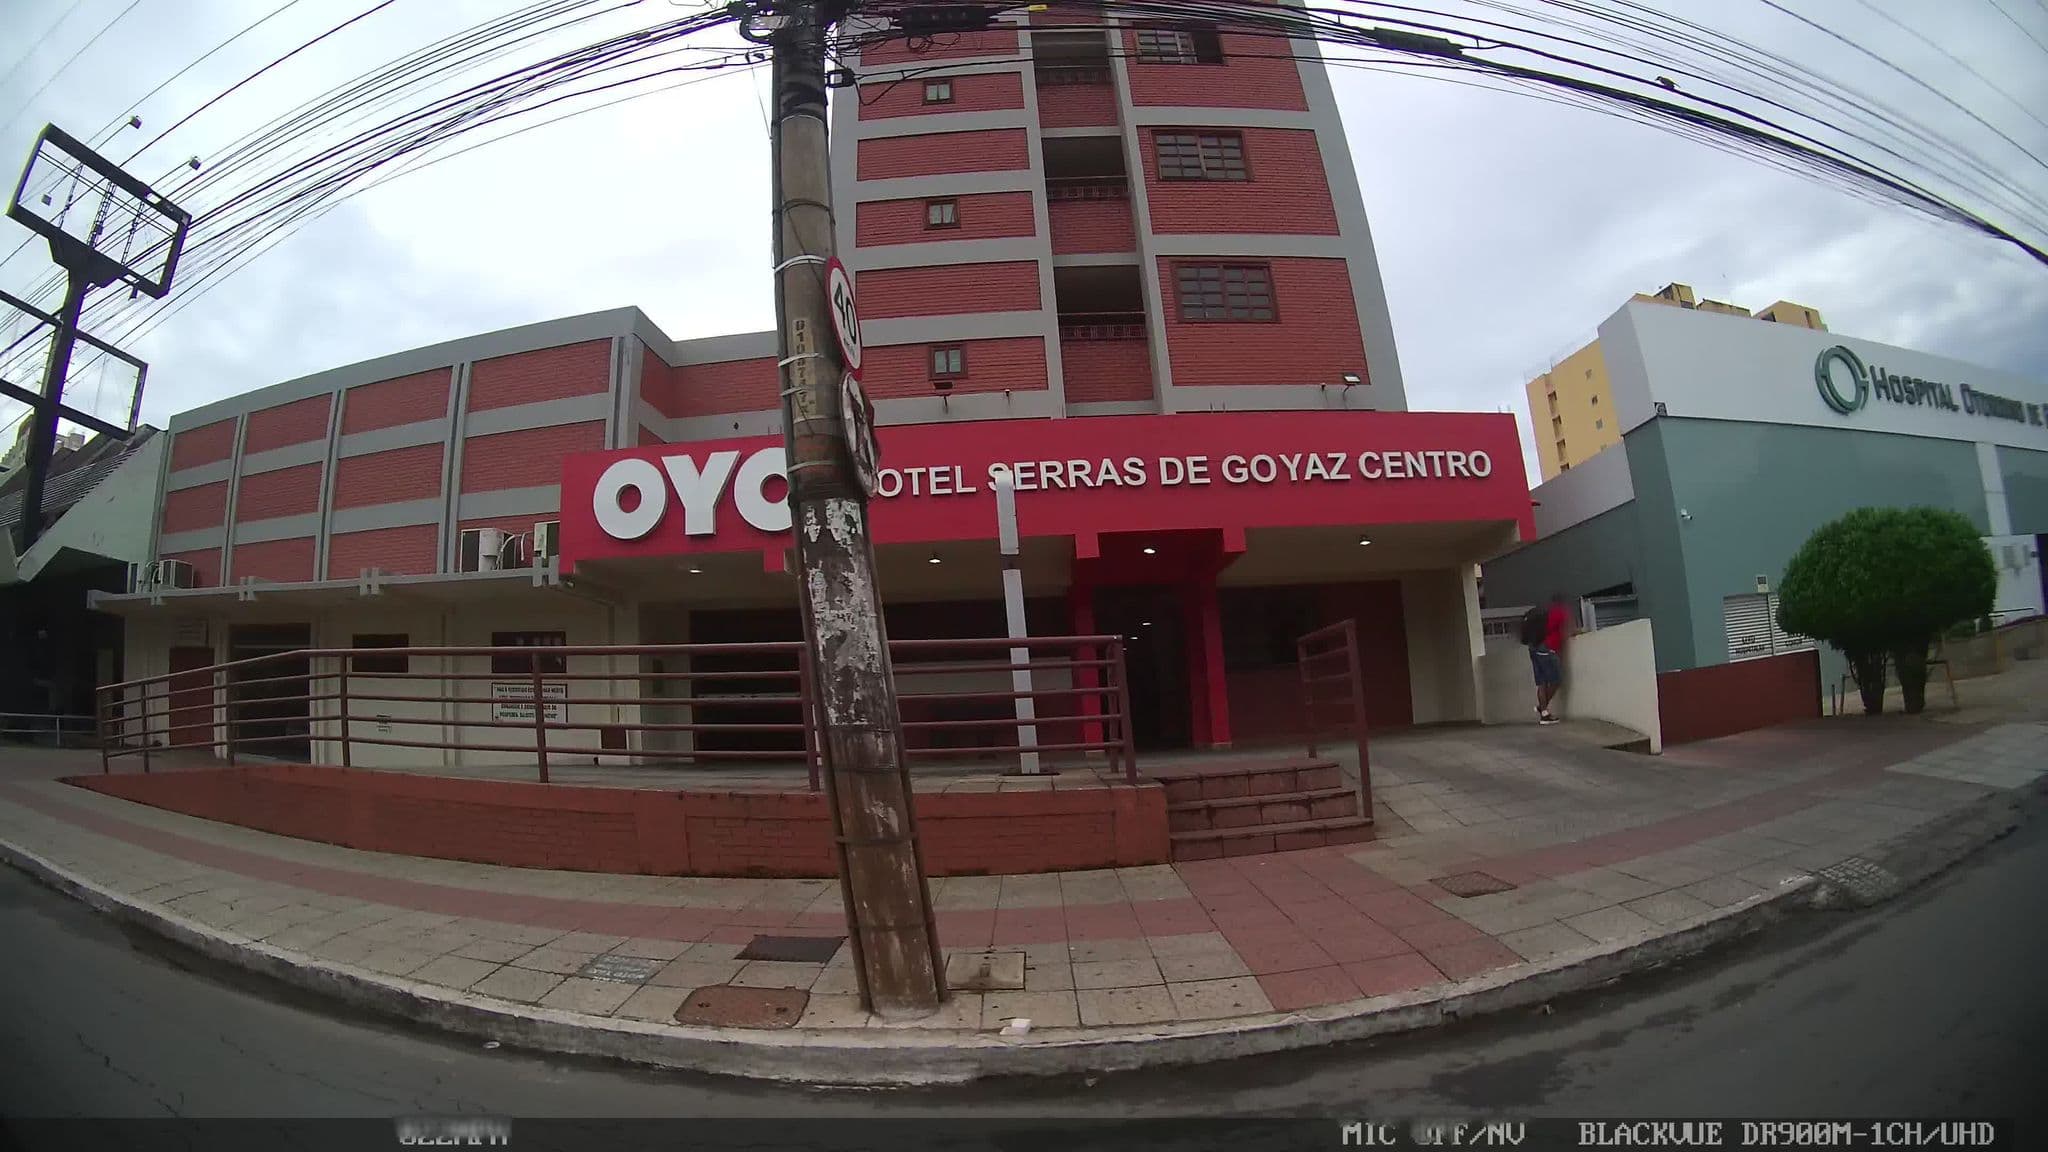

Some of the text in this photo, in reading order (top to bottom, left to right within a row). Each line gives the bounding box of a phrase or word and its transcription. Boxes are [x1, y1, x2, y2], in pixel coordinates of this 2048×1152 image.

[834, 283, 857, 345] 40
[877, 450, 1493, 497] OTEL SERRAS DE GOYAZ CENTRO
